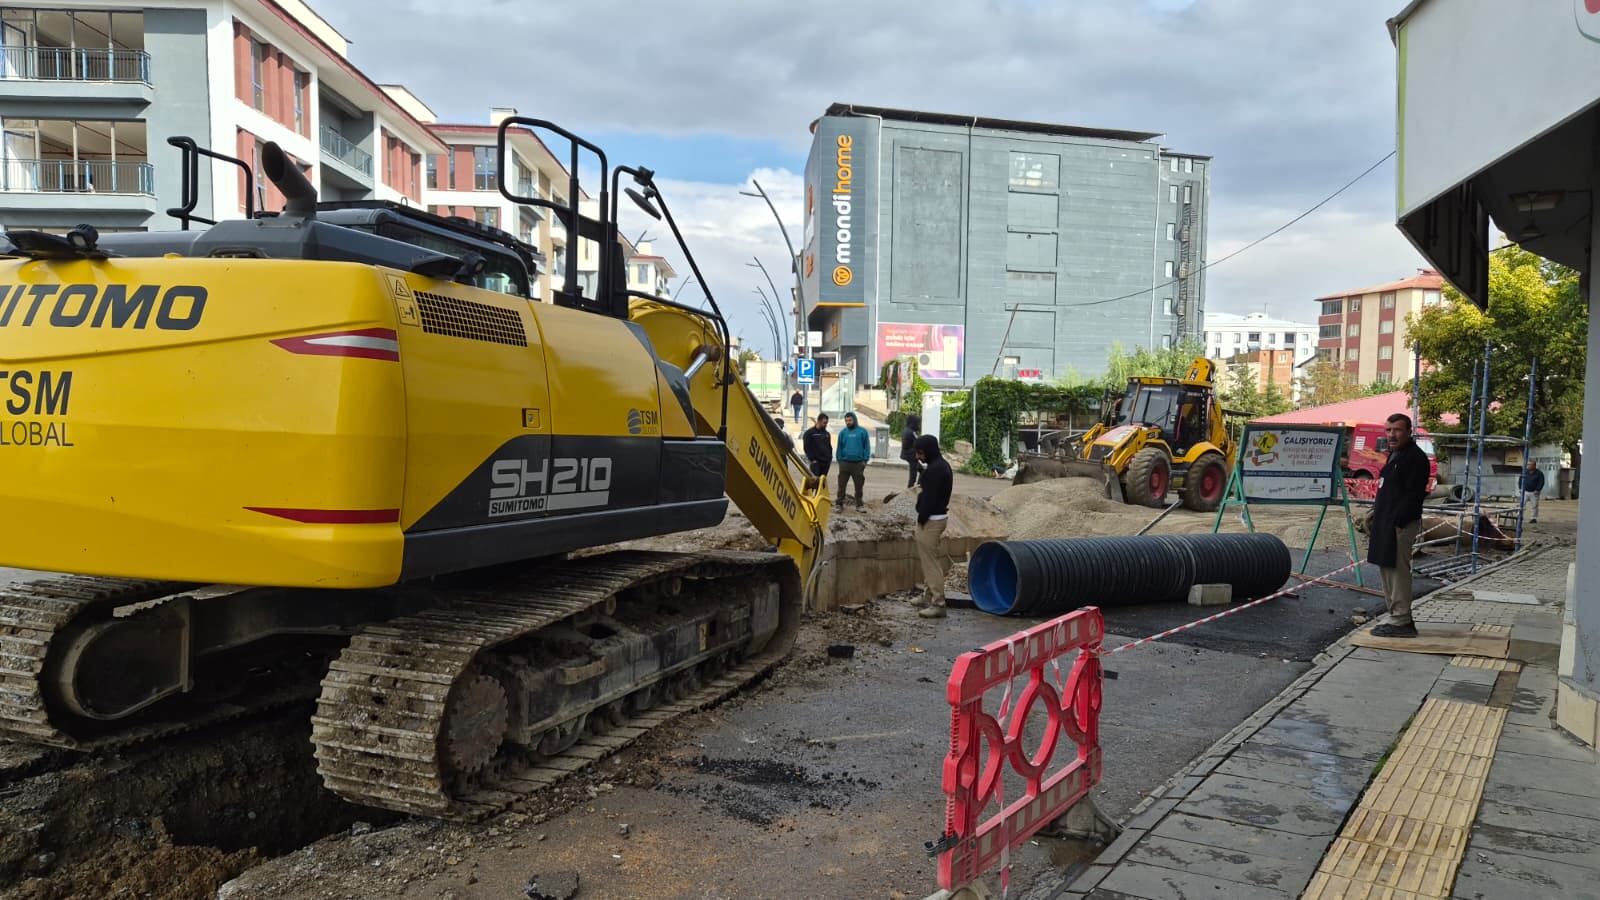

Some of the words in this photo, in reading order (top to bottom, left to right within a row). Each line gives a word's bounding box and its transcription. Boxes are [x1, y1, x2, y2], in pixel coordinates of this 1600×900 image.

[833, 134, 853, 264] mondihome
[0, 284, 208, 331] ITOMO
[801, 361, 811, 374] P
[640, 410, 658, 425] TSM
[490, 457, 612, 499] SH210
[749, 436, 797, 520] SUMITOMO
[490, 498, 545, 514] SUMITOMO
